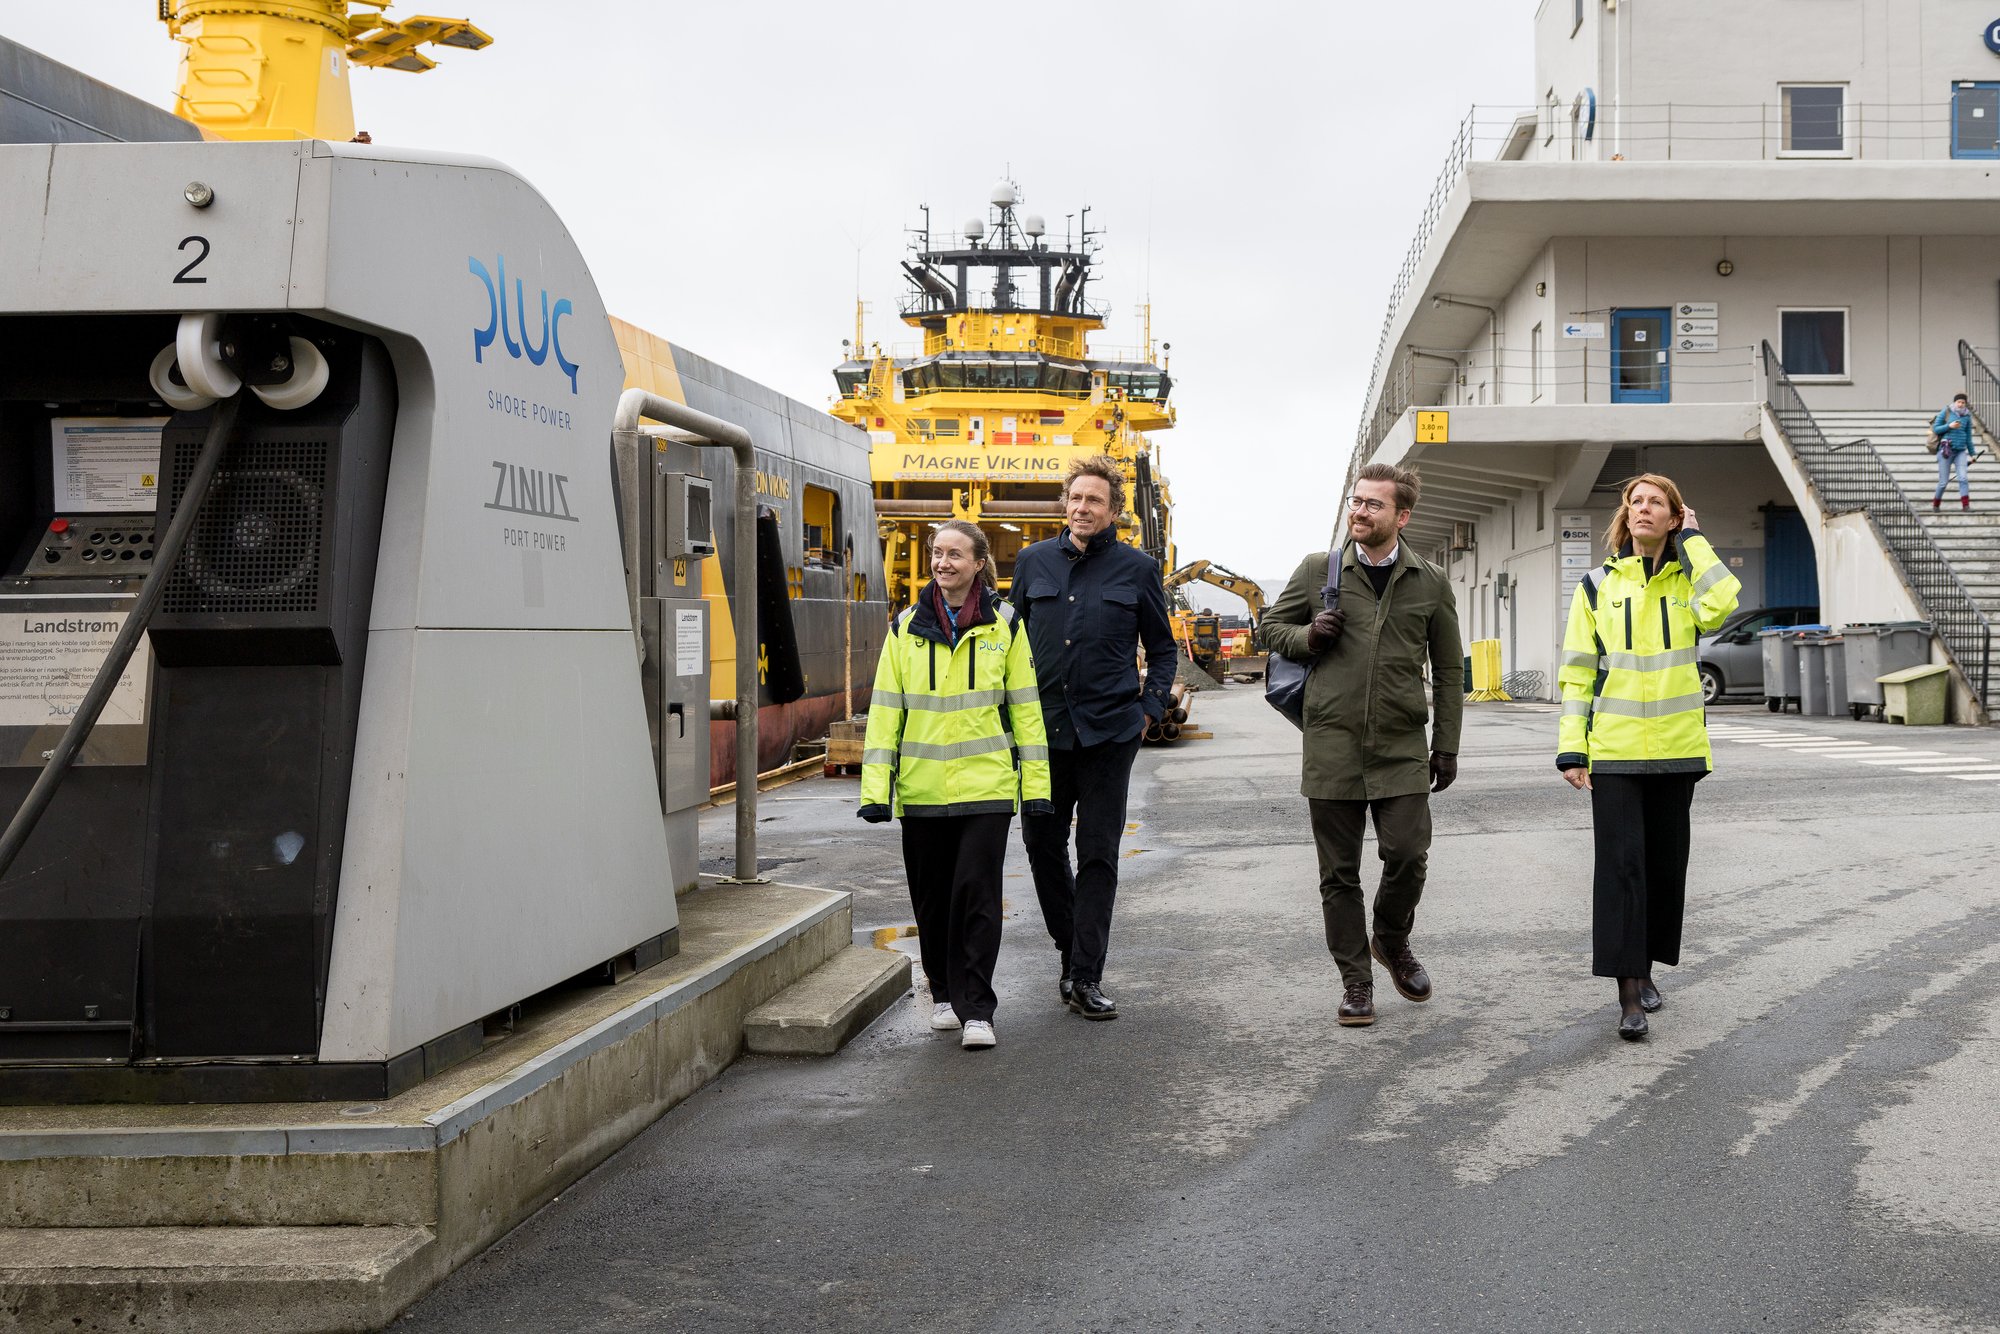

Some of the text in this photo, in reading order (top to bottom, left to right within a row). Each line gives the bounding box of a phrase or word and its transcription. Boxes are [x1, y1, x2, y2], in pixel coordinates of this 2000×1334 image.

[173, 235, 210, 284] 2
[488, 390, 572, 431] SHORE POWER
[486, 460, 577, 521] ZINUS
[504, 528, 566, 552] PORT POWER
[1572, 531, 1590, 539] SDK
[23, 617, 119, 633] Landstrøm
